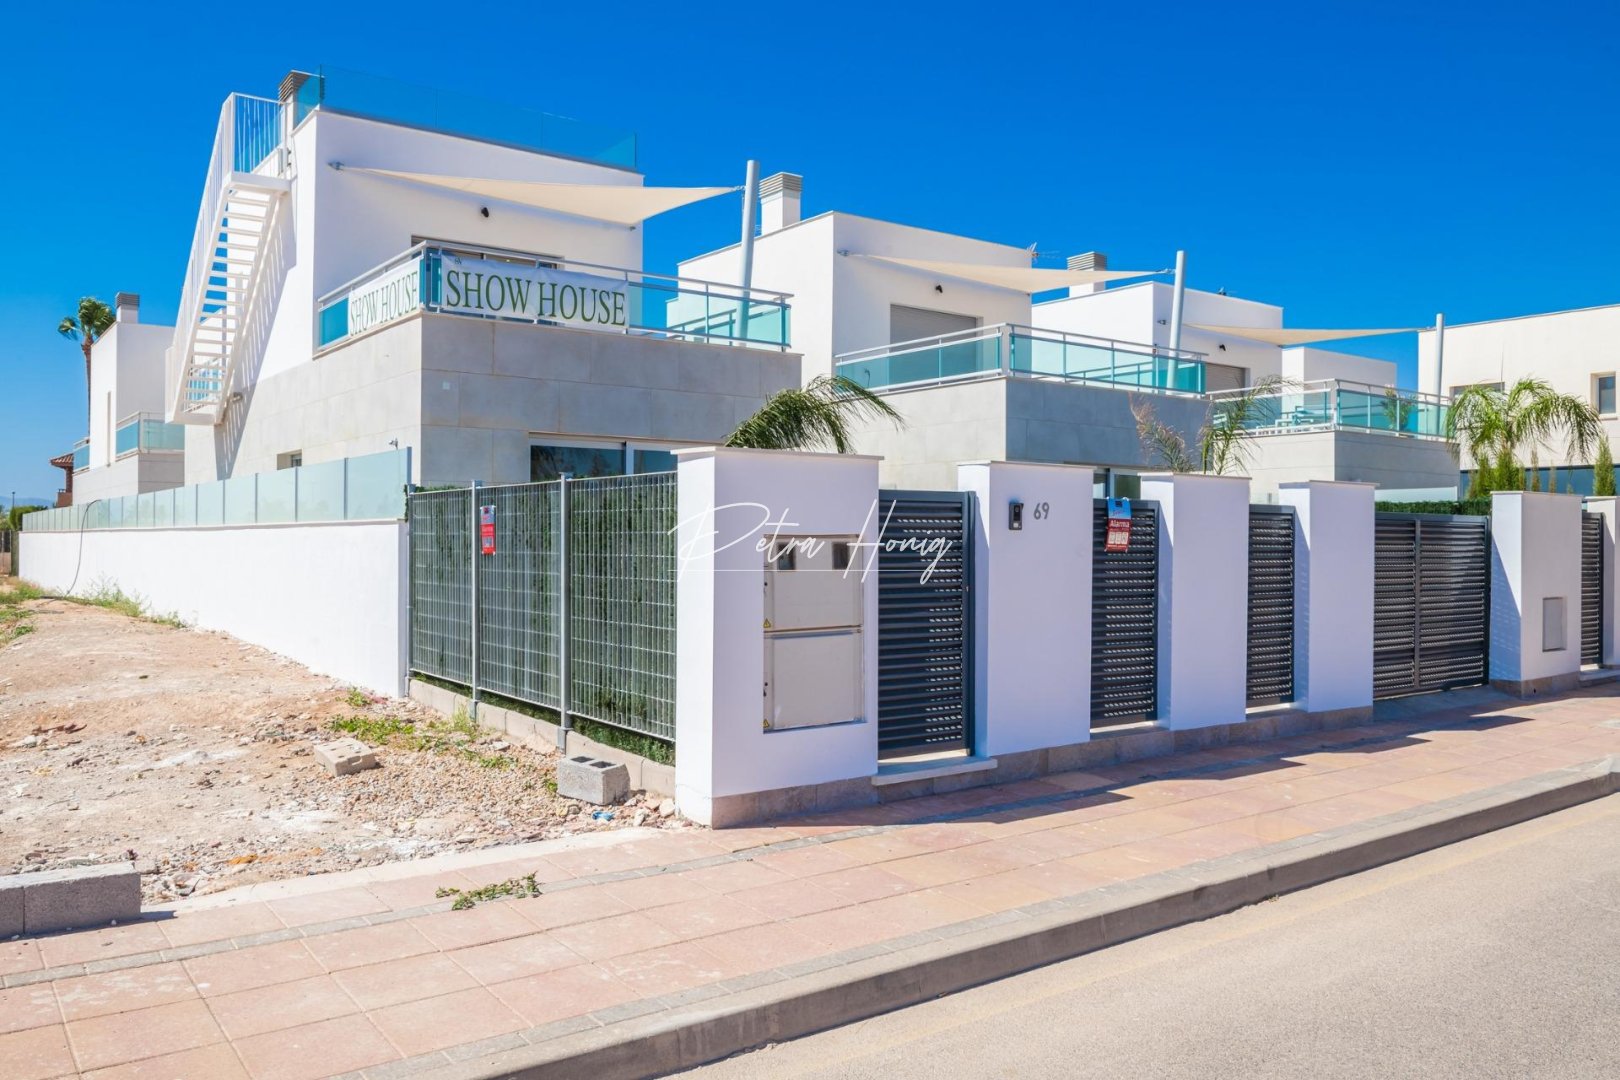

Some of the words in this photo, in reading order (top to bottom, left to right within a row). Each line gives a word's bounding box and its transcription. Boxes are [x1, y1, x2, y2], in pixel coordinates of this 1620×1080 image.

[350, 289, 379, 337] SHOW
[380, 271, 418, 323] HOUSE
[446, 270, 531, 314] SHOW
[538, 282, 626, 326] HOUSE
[1033, 502, 1049, 520] 69
